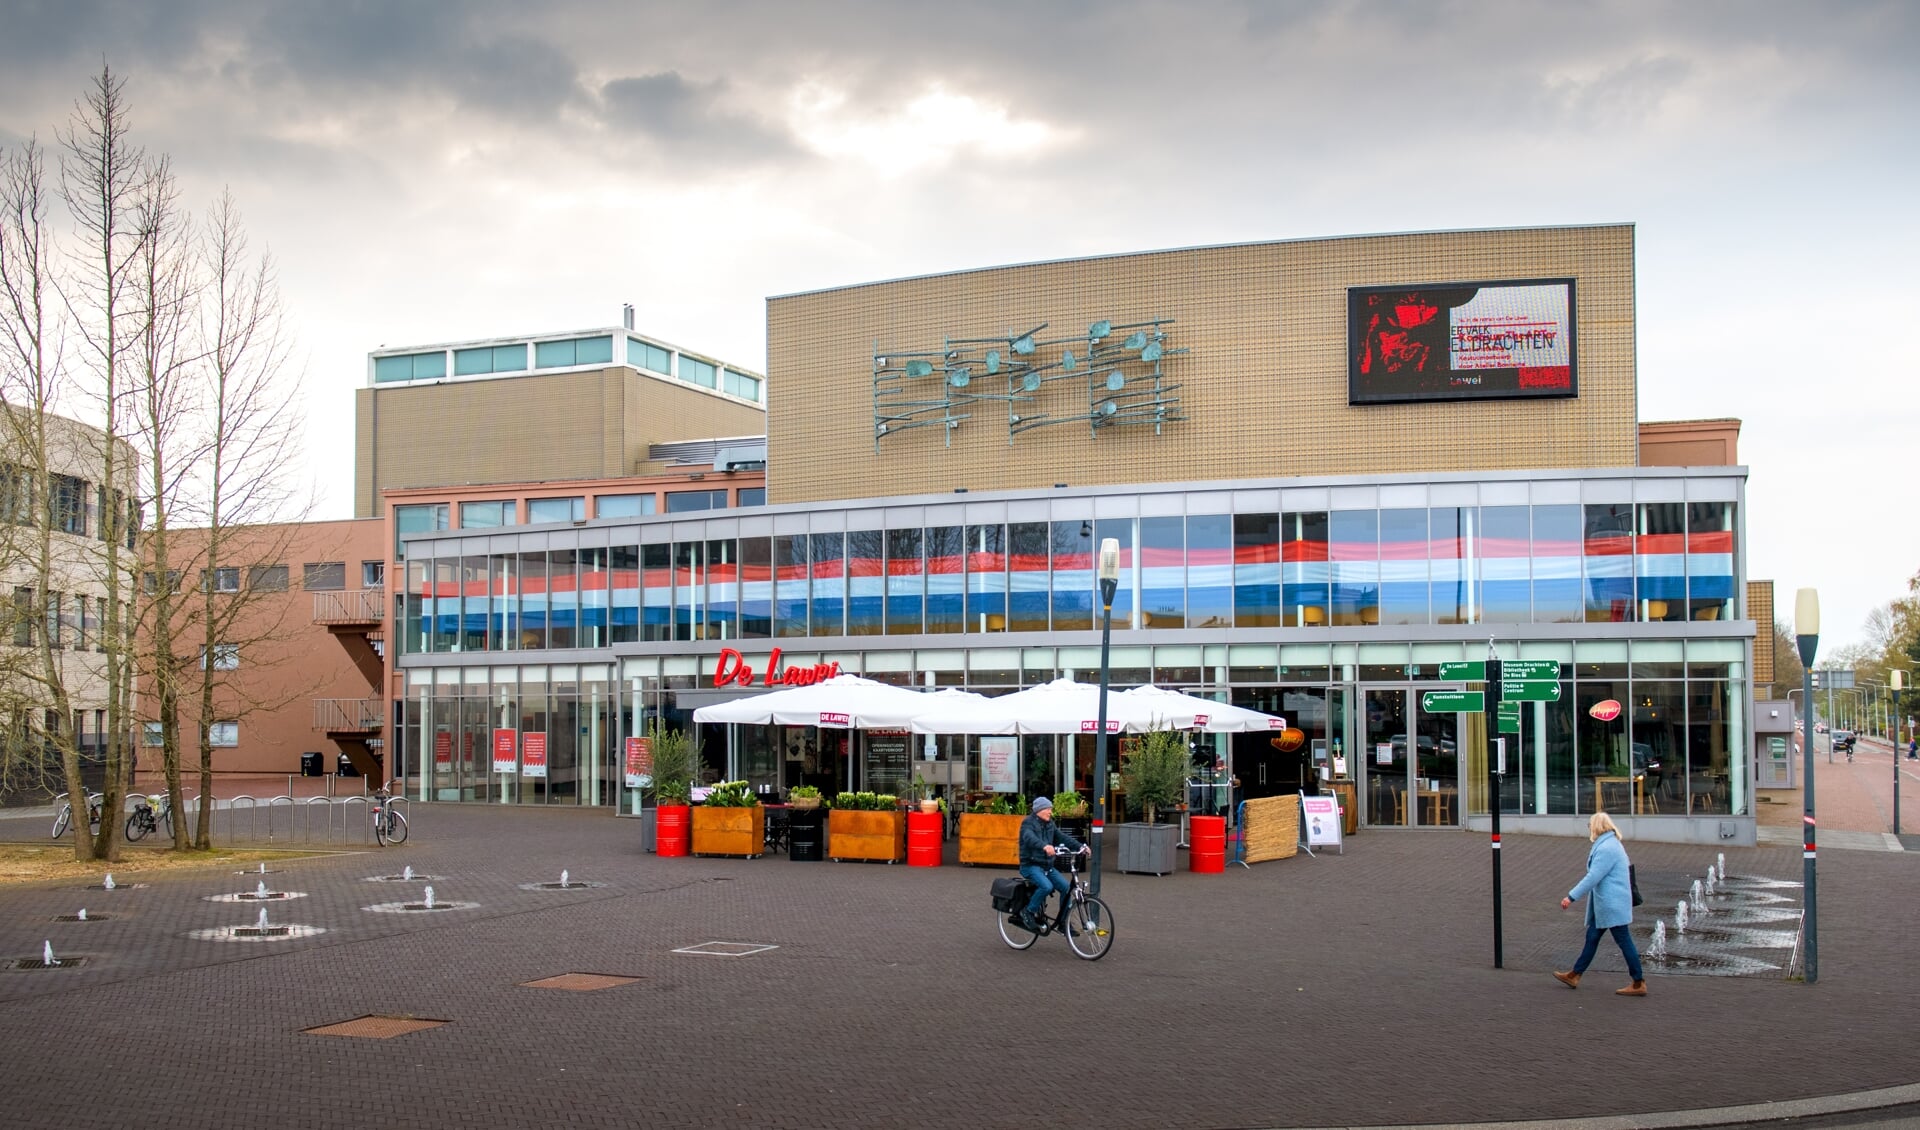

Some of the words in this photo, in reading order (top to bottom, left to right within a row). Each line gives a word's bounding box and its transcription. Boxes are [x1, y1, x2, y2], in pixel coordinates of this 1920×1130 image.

[1466, 324, 1490, 335] VALK
[1472, 333, 1554, 352] DRACHTEN
[713, 648, 754, 687] De
[764, 648, 840, 686] Lawei
[830, 714, 848, 722] LAWEI
[1082, 722, 1094, 730] DE
[1095, 722, 1118, 730] LWEI
